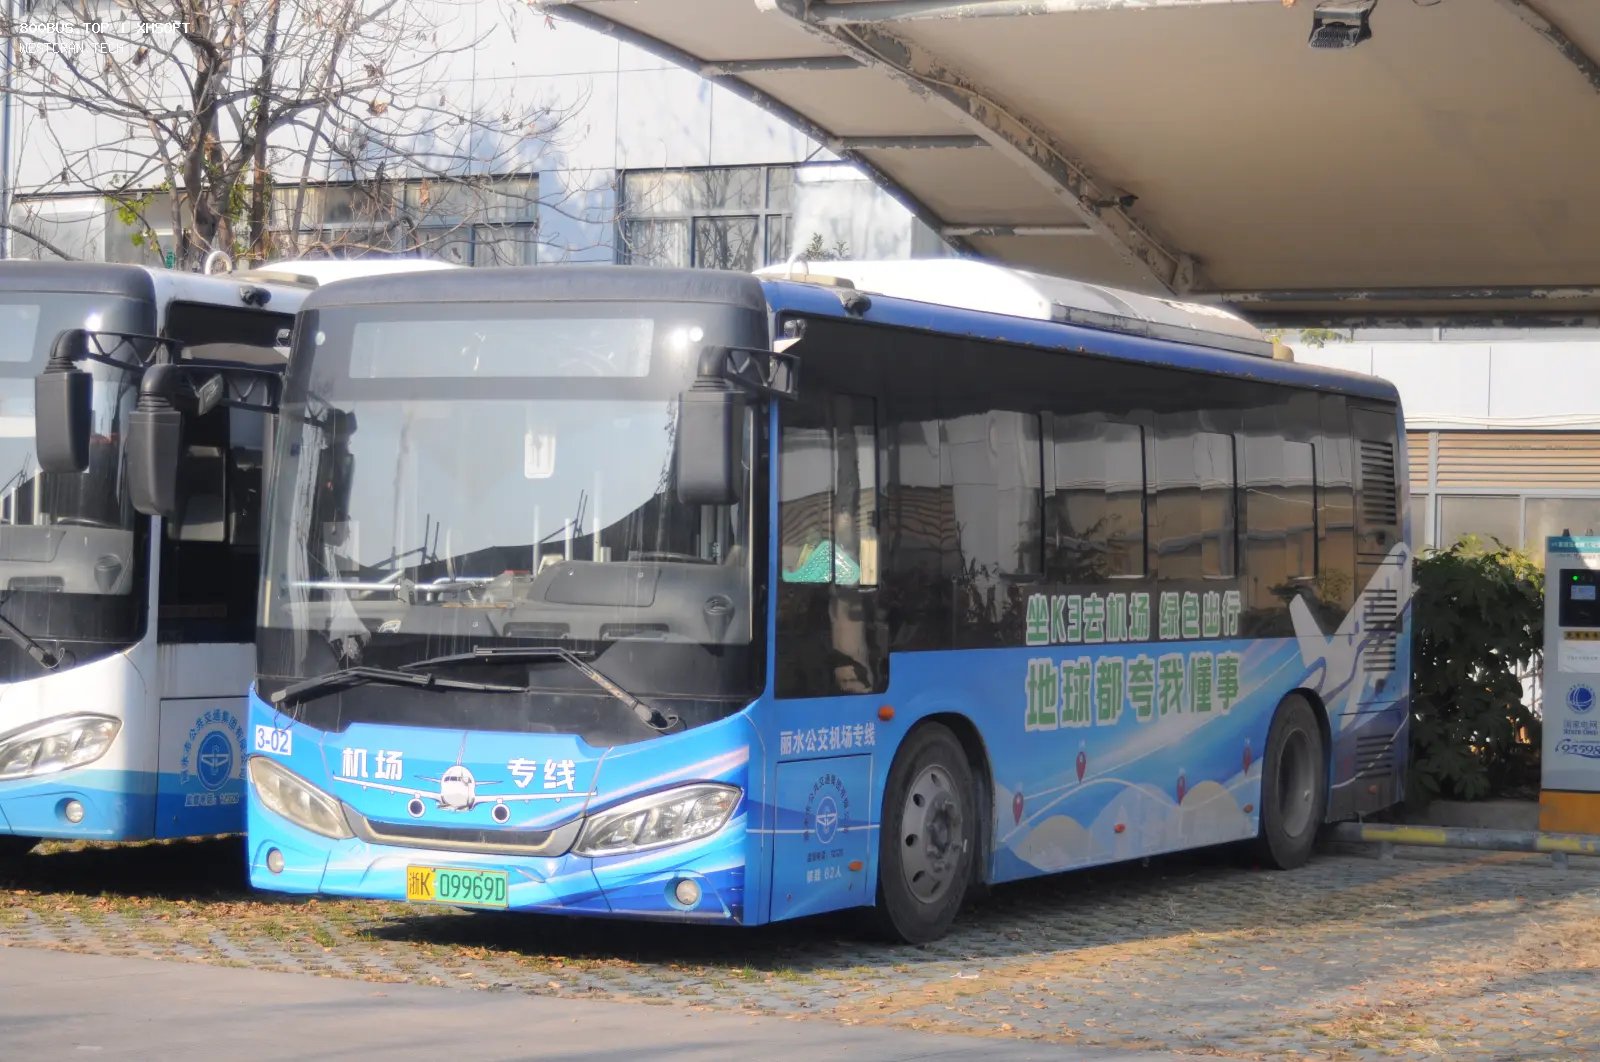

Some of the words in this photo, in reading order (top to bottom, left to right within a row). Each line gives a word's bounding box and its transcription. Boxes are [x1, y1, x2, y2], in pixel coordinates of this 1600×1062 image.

[1025, 591, 1150, 646] 坐K3去机场
[1159, 590, 1241, 640] 绿色出行
[1025, 651, 1241, 732] 地球都夸我懂事
[256, 727, 289, 754] 3-02
[780, 722, 877, 756] 丽水公交机场专线
[341, 747, 404, 781] 机场
[507, 757, 577, 791] 专线
[408, 871, 431, 898] 浙K
[439, 873, 506, 902] 09969D
